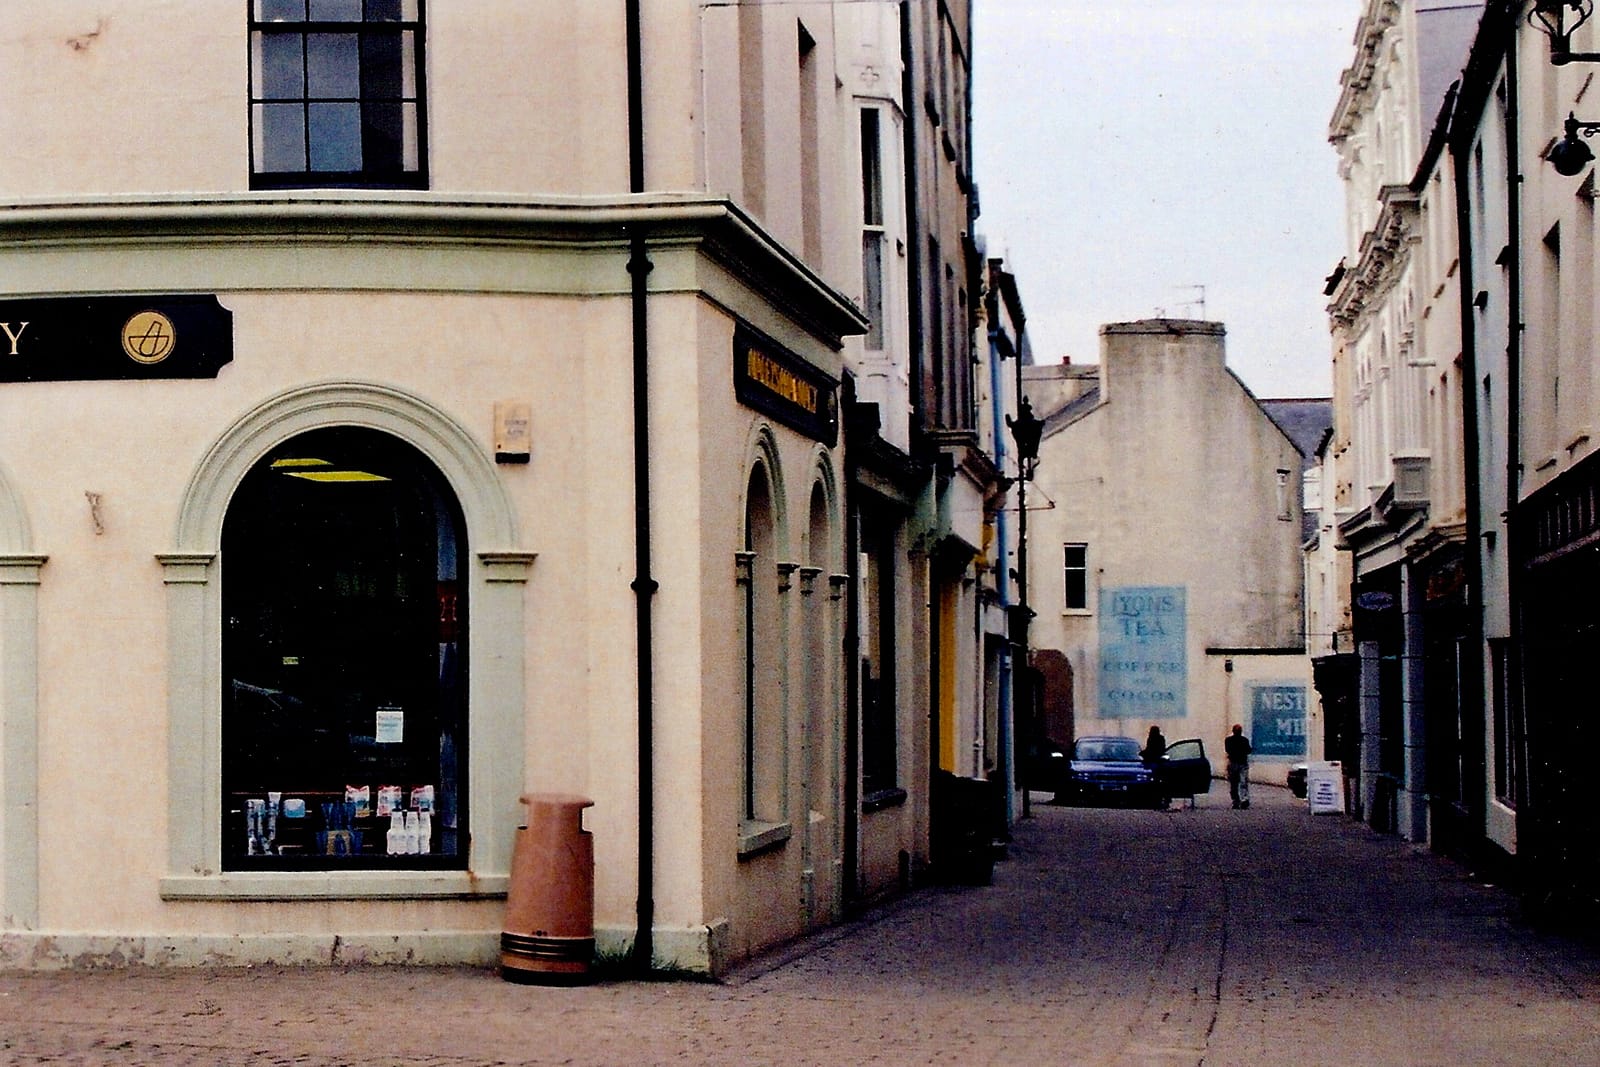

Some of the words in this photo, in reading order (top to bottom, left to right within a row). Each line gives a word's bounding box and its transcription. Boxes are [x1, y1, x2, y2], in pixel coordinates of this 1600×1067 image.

[0, 321, 30, 355] Y
[1111, 593, 1175, 616] LYONS
[1119, 617, 1167, 636] TEA
[1107, 689, 1175, 701] COCOA
